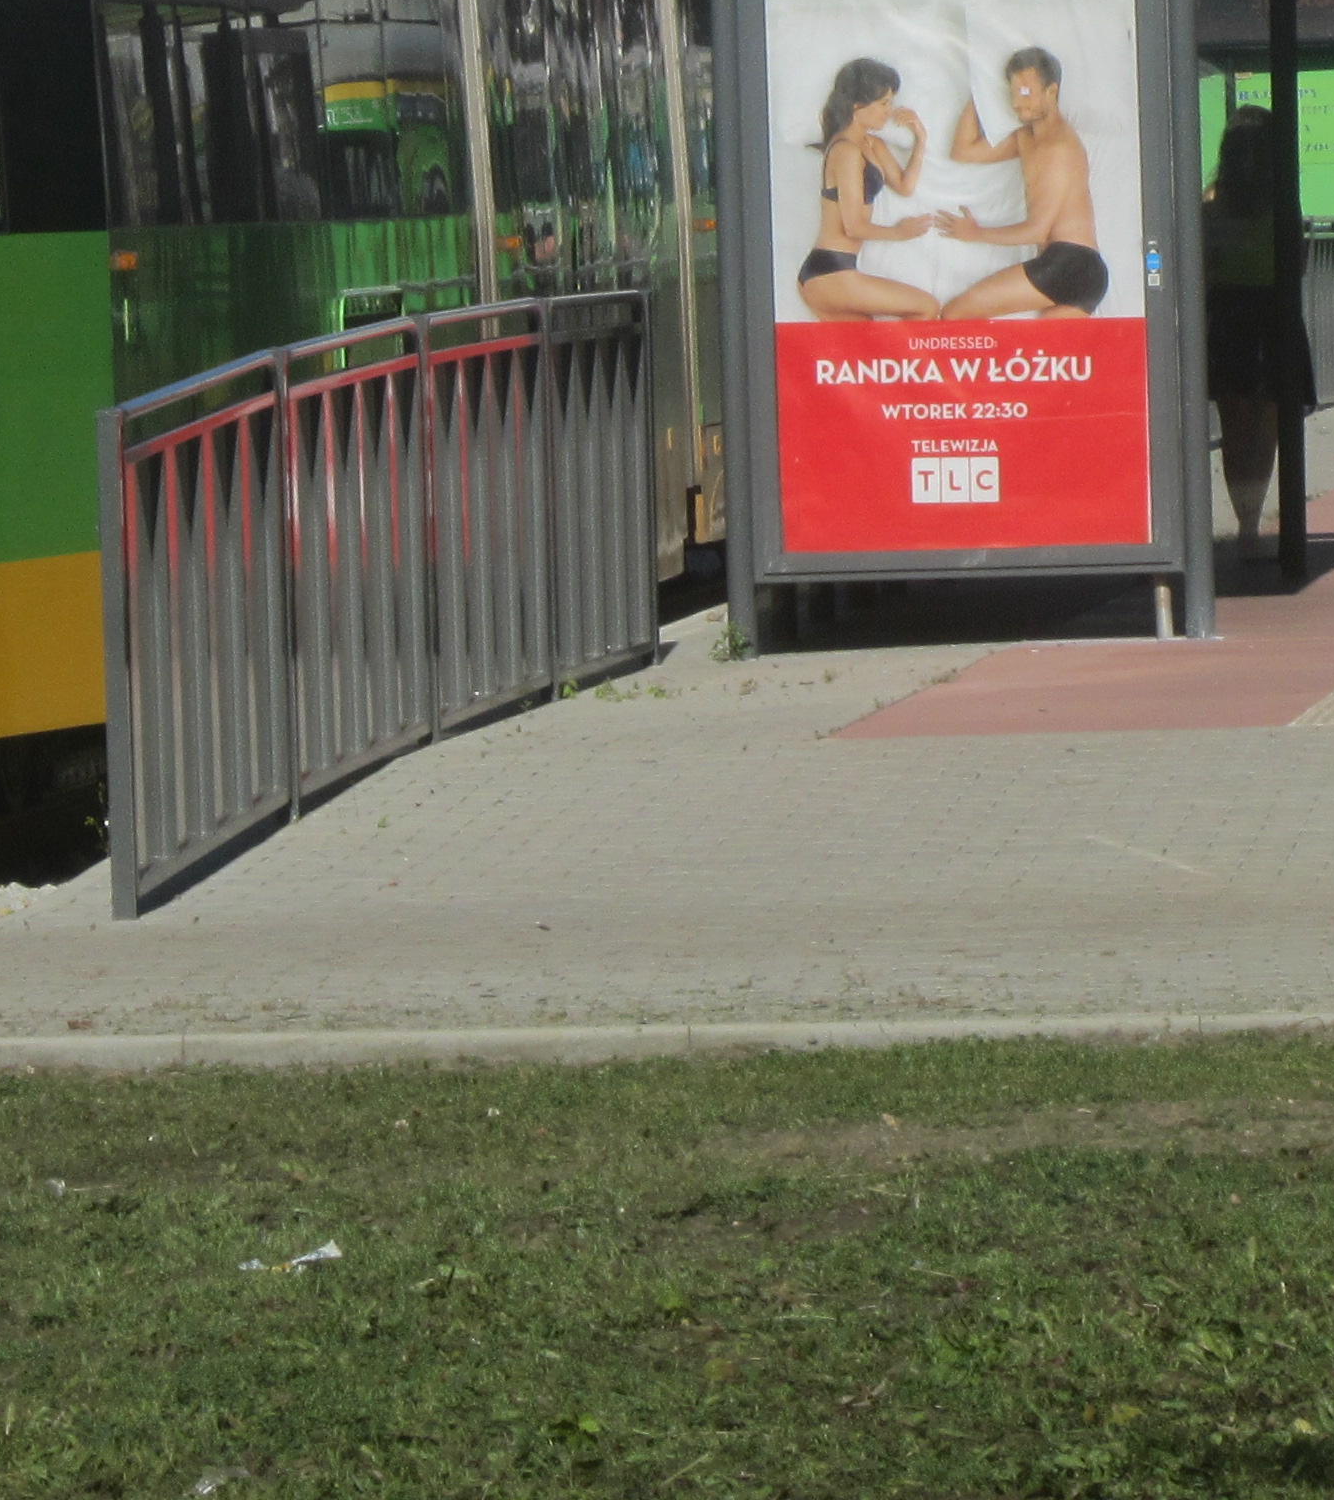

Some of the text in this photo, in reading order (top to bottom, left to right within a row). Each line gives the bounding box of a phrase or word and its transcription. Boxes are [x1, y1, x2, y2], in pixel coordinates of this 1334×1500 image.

[908, 336, 999, 351] UNDRESSED:
[815, 348, 1093, 385] RANDKA W ŁÓŻKU
[881, 402, 1029, 420] WTOREK 22:30
[911, 438, 999, 454] TELEWIZJA
[917, 469, 995, 492] TLC
